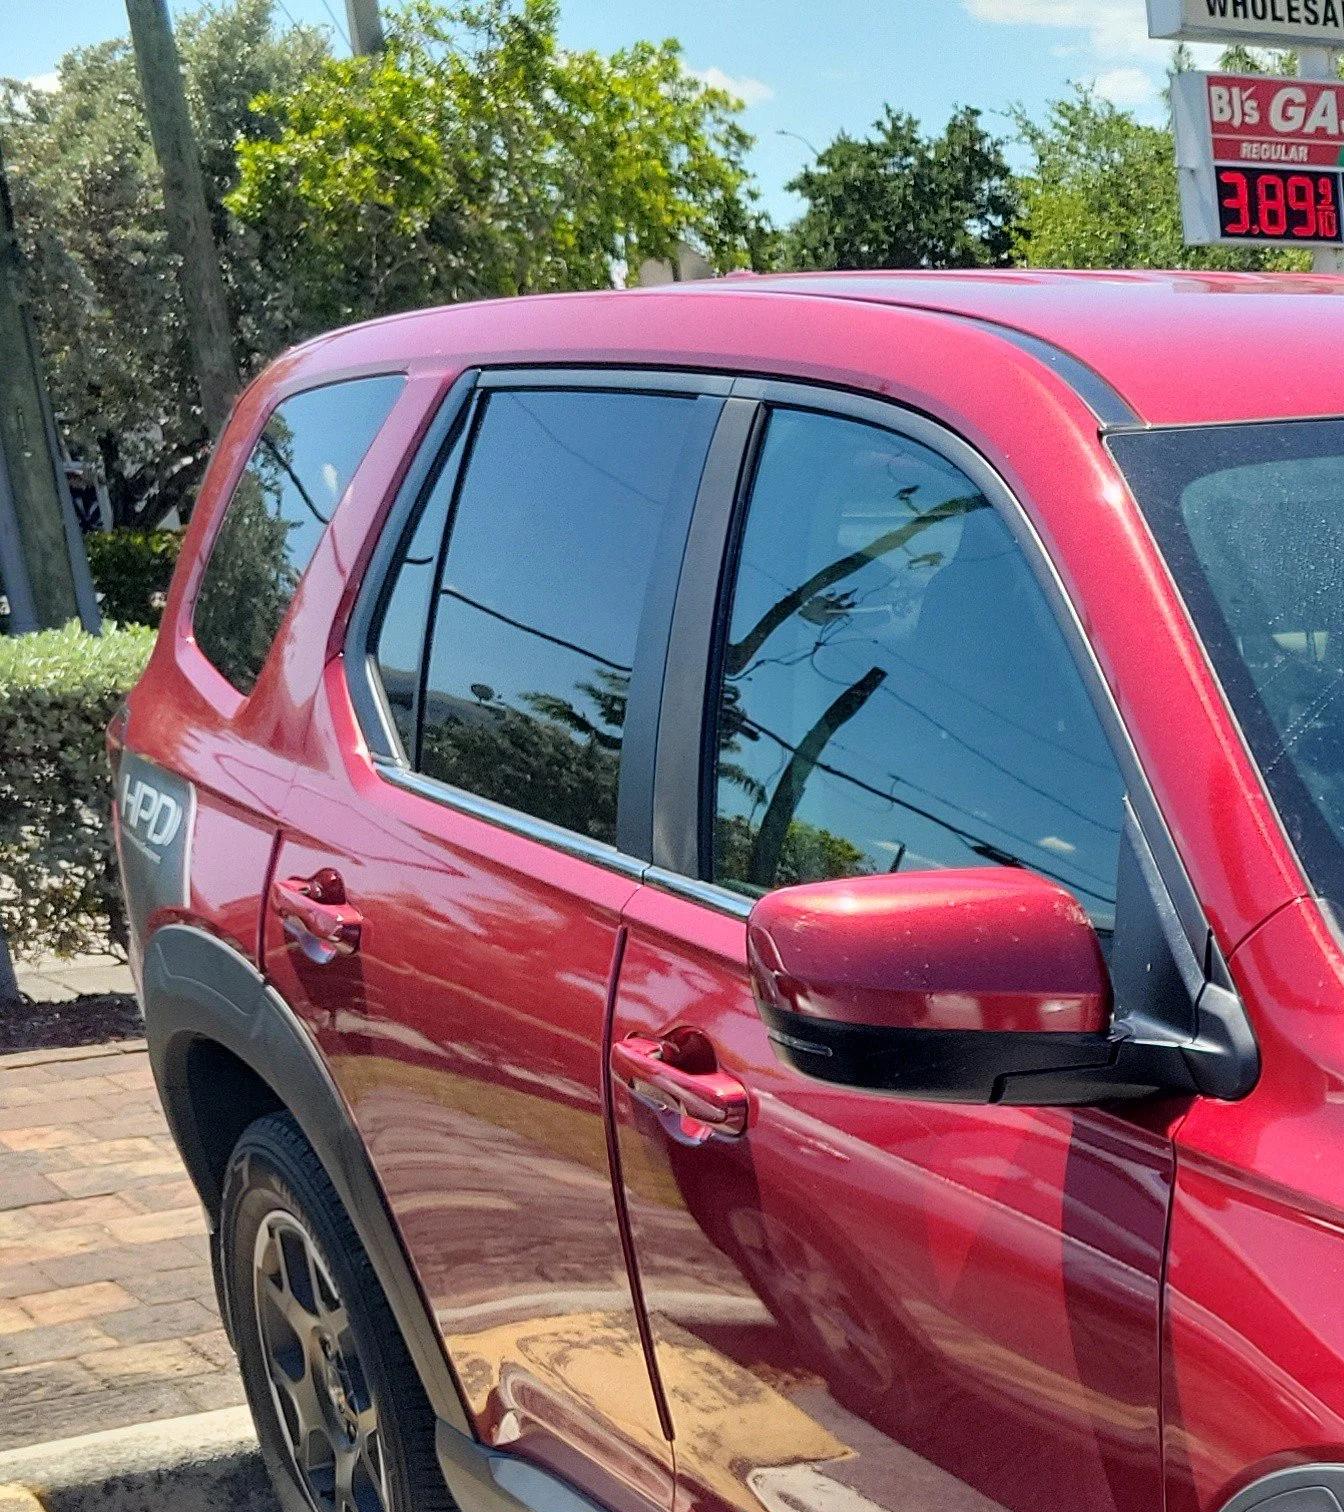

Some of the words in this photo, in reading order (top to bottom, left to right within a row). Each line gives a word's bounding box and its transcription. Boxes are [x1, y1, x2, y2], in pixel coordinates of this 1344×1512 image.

[1209, 85, 1260, 128] BJ's
[1240, 142, 1308, 163] REGULAR
[1219, 171, 1316, 237] 3.89
